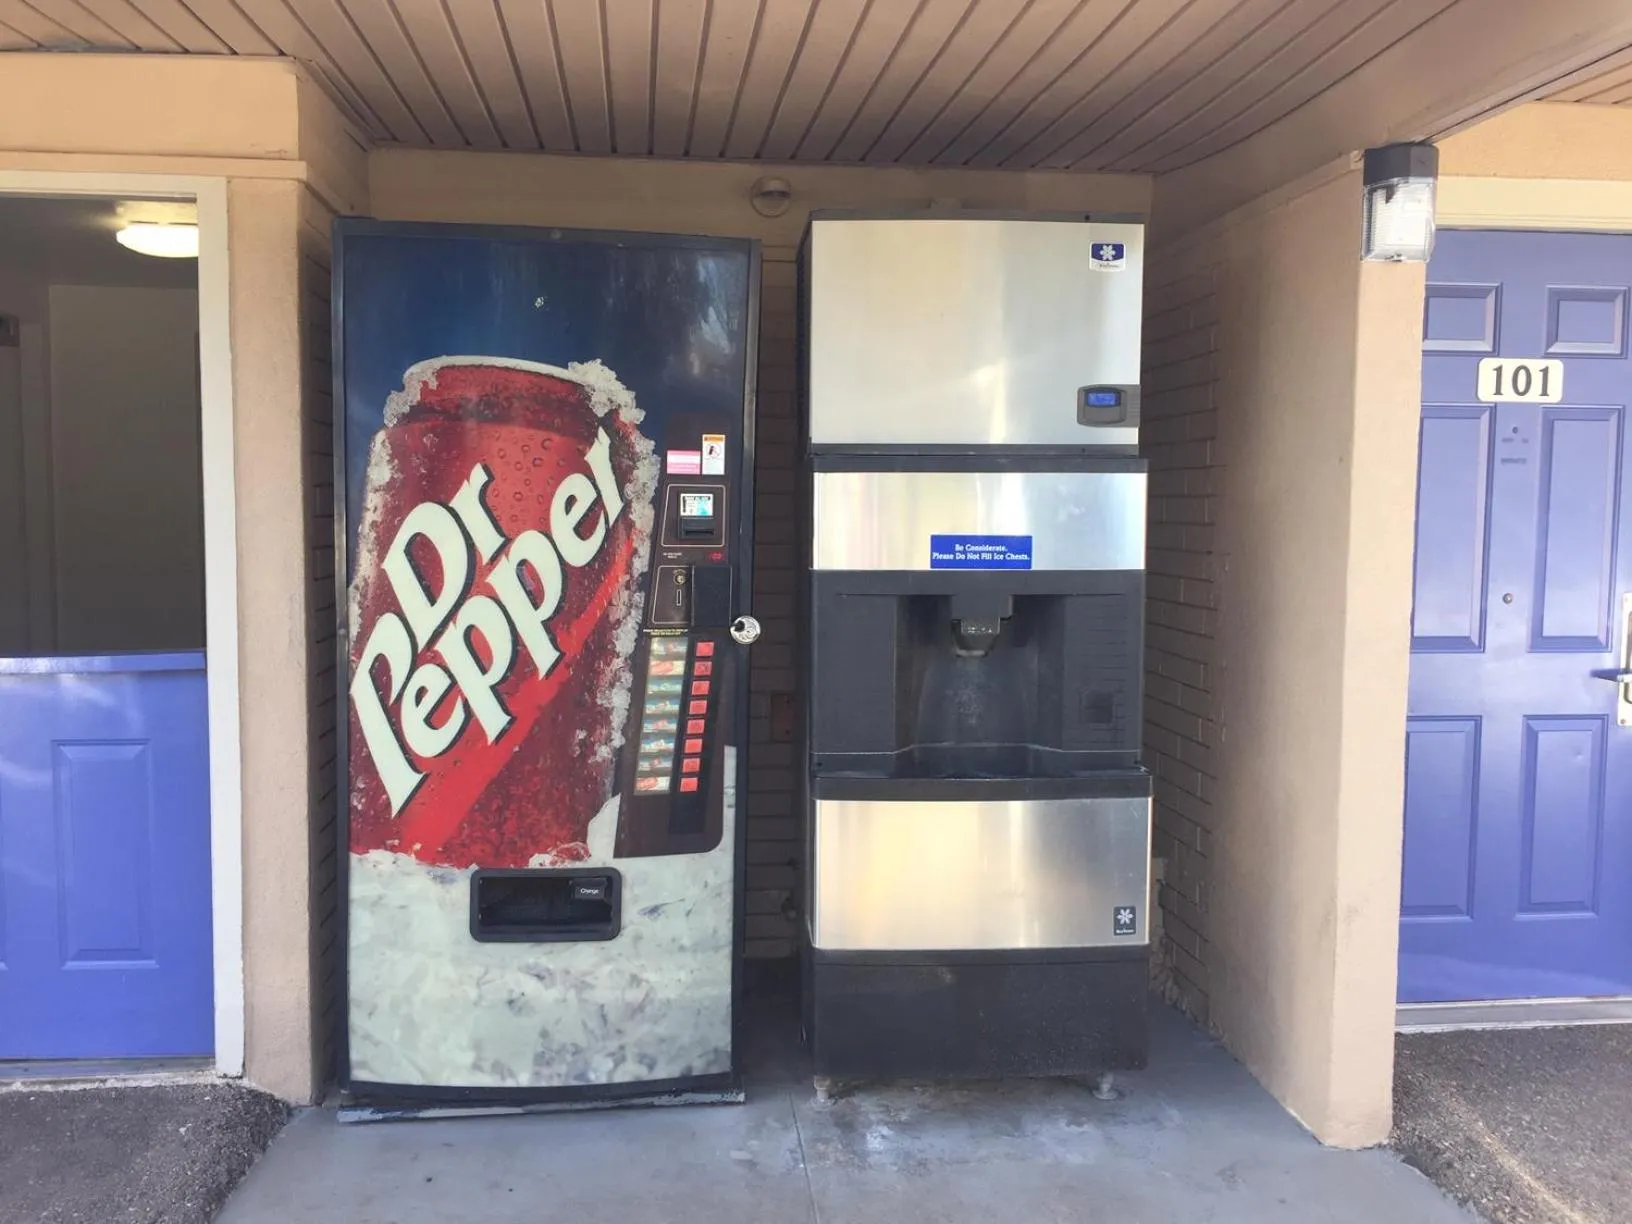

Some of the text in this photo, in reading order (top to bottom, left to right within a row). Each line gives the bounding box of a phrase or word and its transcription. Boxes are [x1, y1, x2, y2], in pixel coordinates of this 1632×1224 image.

[1492, 364, 1551, 397] 101
[382, 462, 505, 650] Dr
[932, 552, 1030, 561] Please Do Not Fill Ice Chests.
[965, 544, 1008, 552] Considerate.
